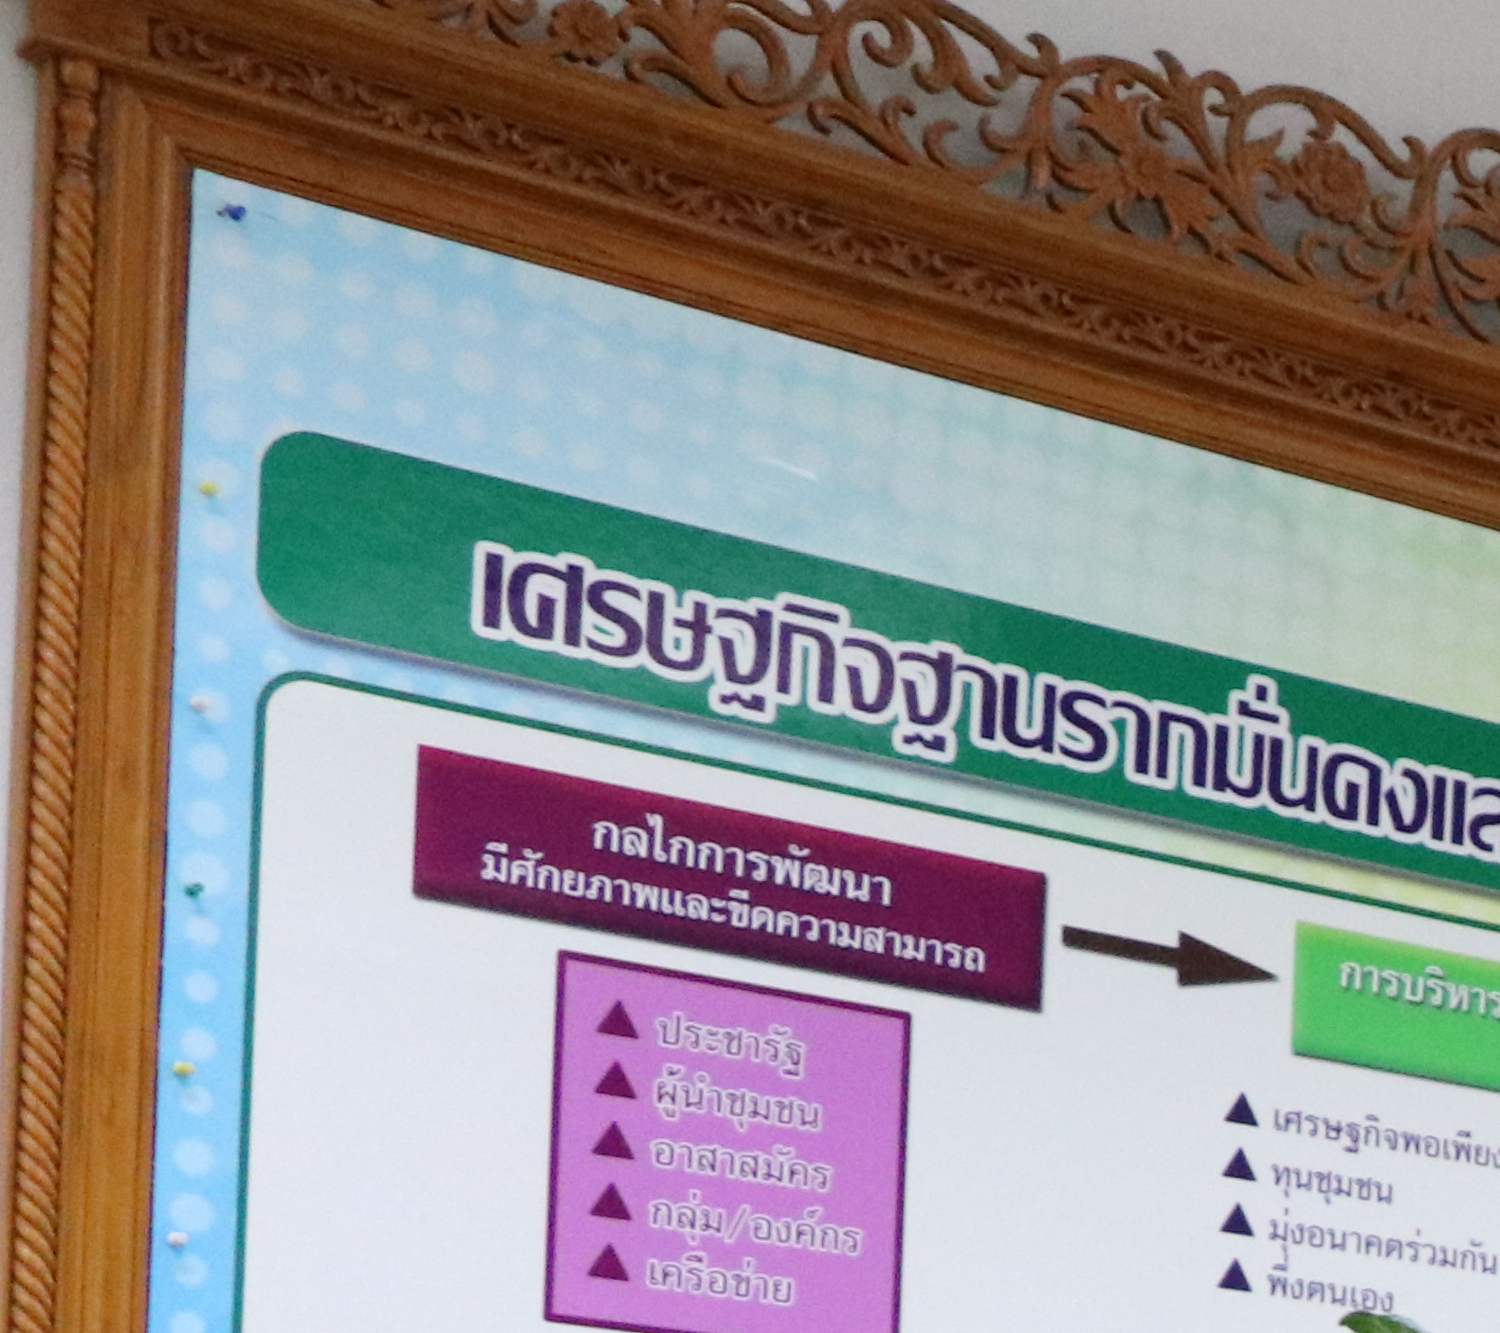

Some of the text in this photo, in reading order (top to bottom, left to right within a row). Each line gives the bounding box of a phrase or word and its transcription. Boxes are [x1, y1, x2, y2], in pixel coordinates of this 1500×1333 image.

[591, 814, 892, 906] กลไกการพัฒนา
[481, 847, 986, 974] มีศักยภาพและขีดความสามารถ
[657, 1012, 805, 1078] ประชารัฐ
[656, 1066, 821, 1130] ผู้นำชุมชน
[651, 1137, 832, 1191] อาสาสมัคร
[1271, 1159, 1393, 1206] ทุนชุมชน
[1269, 1208, 1498, 1276] มุ่งอนาคตร่วมกัน
[647, 1251, 794, 1306] เครือข่าย
[1268, 1250, 1394, 1313] พึ่งตนเอง
